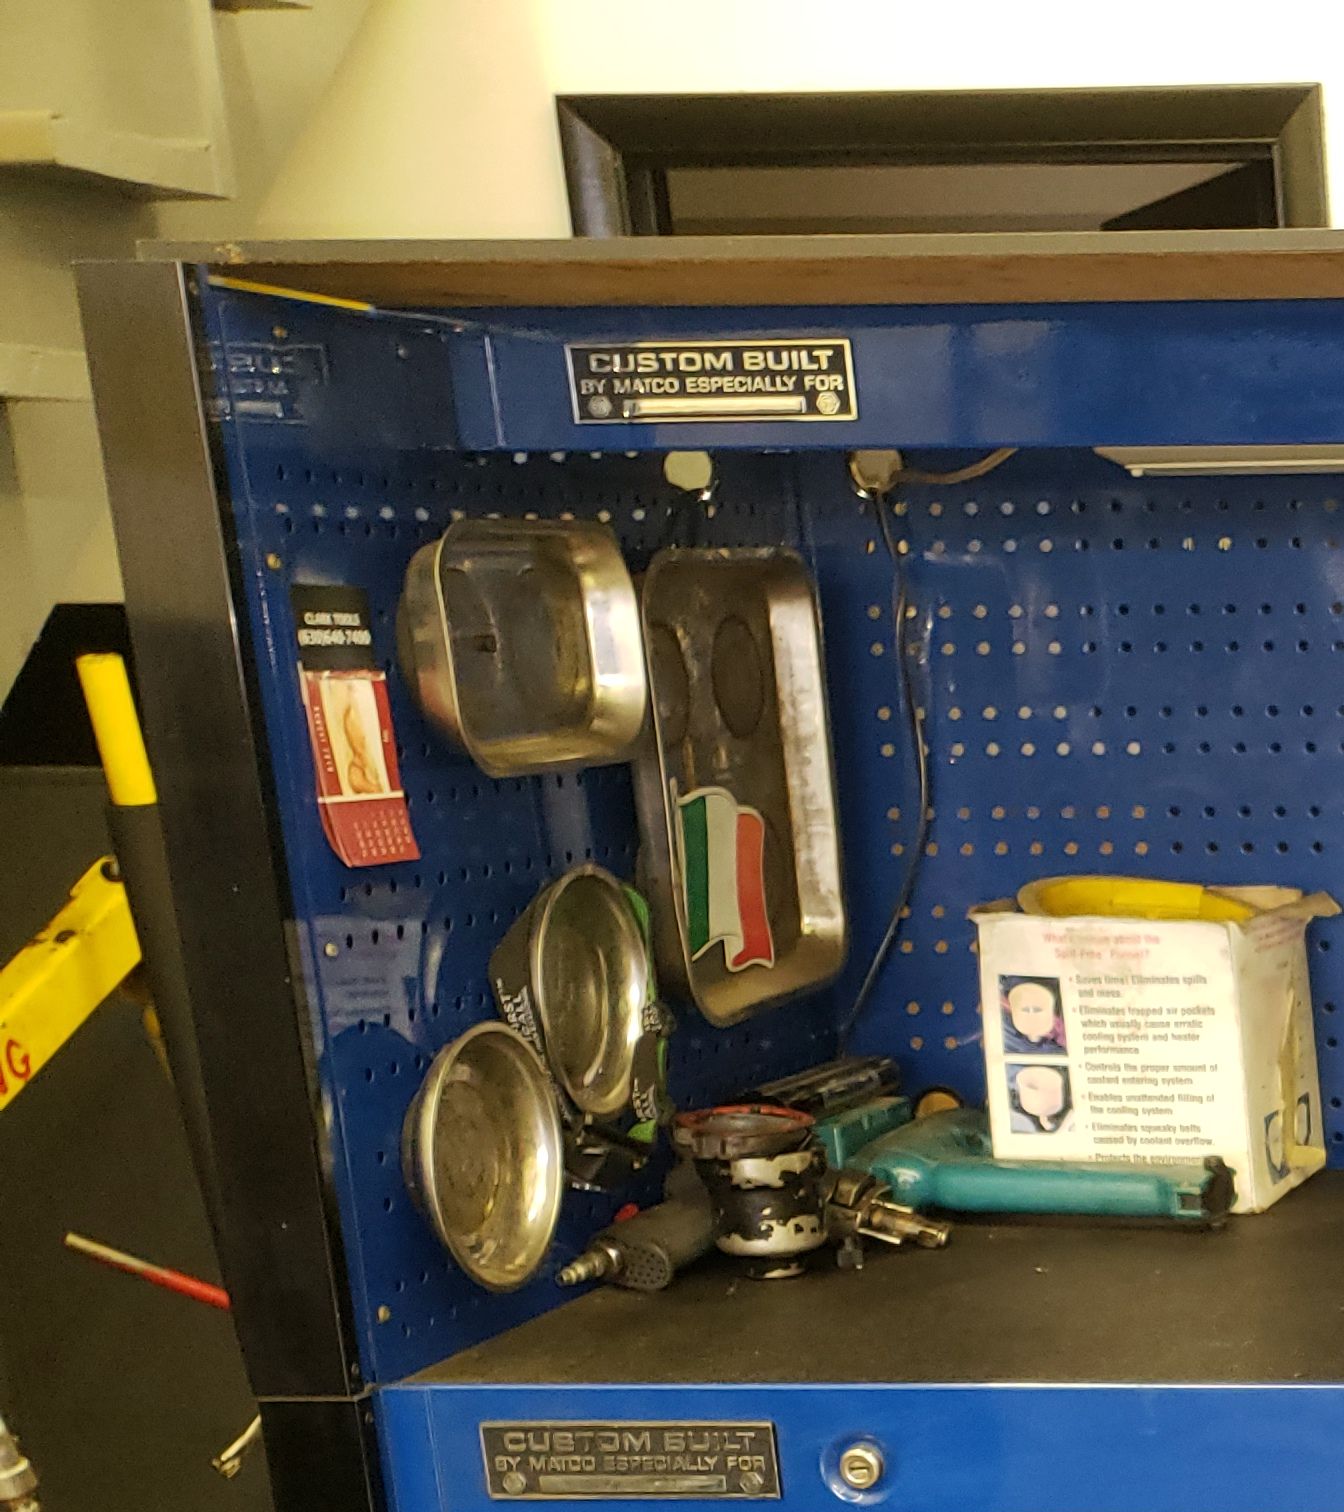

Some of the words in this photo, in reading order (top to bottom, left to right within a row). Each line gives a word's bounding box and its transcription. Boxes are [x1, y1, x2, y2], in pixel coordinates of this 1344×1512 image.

[589, 351, 734, 374] CUSTOM
[742, 349, 835, 371] BUILT
[580, 378, 606, 395] BY
[612, 376, 680, 395] MATCO
[685, 375, 797, 394] ESPECIALLY
[803, 374, 845, 392] FOR
[1085, 1062, 1121, 1072] Controls
[1123, 1063, 1138, 1072] the
[1092, 1122, 1138, 1132] Eliminates
[1093, 1136, 1124, 1145] caused
[1125, 1135, 1137, 1146] by
[1139, 1136, 1172, 1145] coolant
[502, 1430, 651, 1454] CUSTOM
[663, 1430, 756, 1453] BUILT
[494, 1455, 523, 1472] BY
[527, 1455, 597, 1472] MATCO
[604, 1455, 719, 1472] ESPECIALLY
[726, 1455, 766, 1472] FOR
